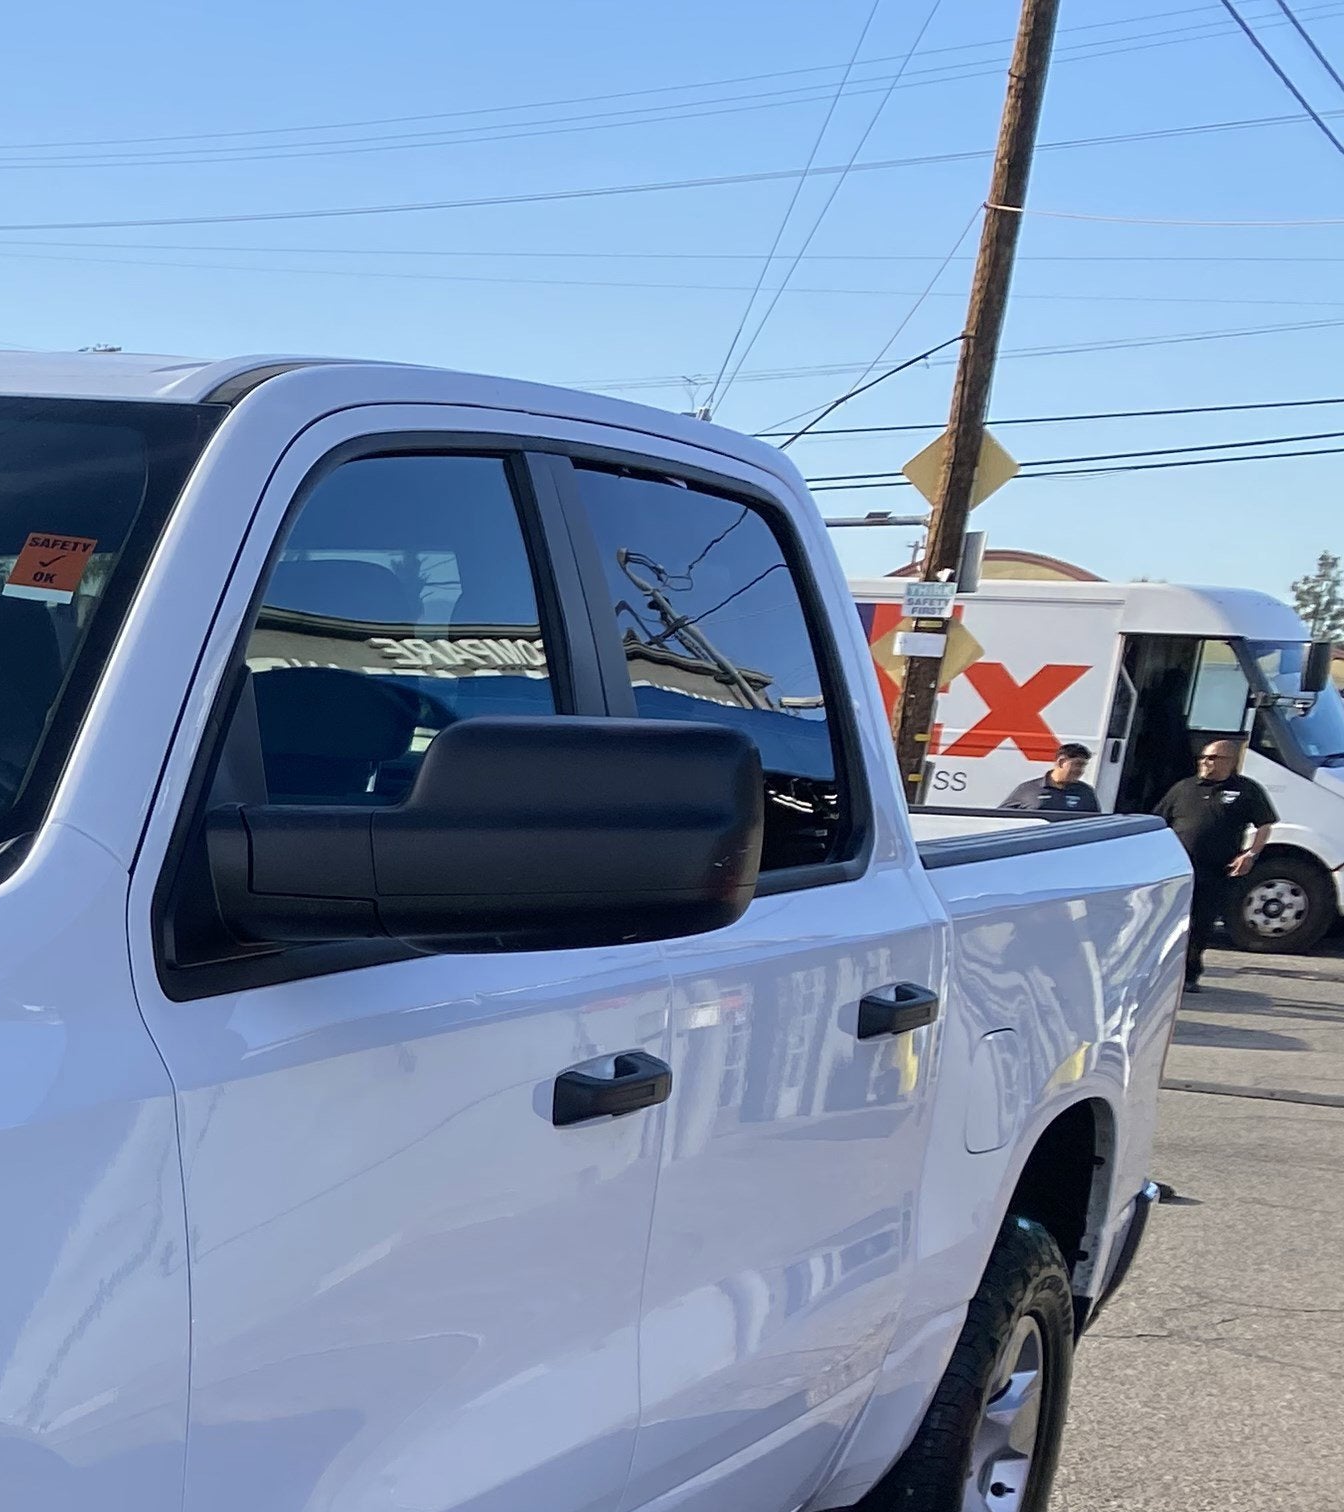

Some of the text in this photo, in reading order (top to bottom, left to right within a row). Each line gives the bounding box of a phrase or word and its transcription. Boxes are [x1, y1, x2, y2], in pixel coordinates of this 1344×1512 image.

[28, 537, 92, 552] SAFETY
[33, 571, 57, 583] OK
[905, 597, 950, 606] SAFETY
[911, 606, 944, 615] FIRST
